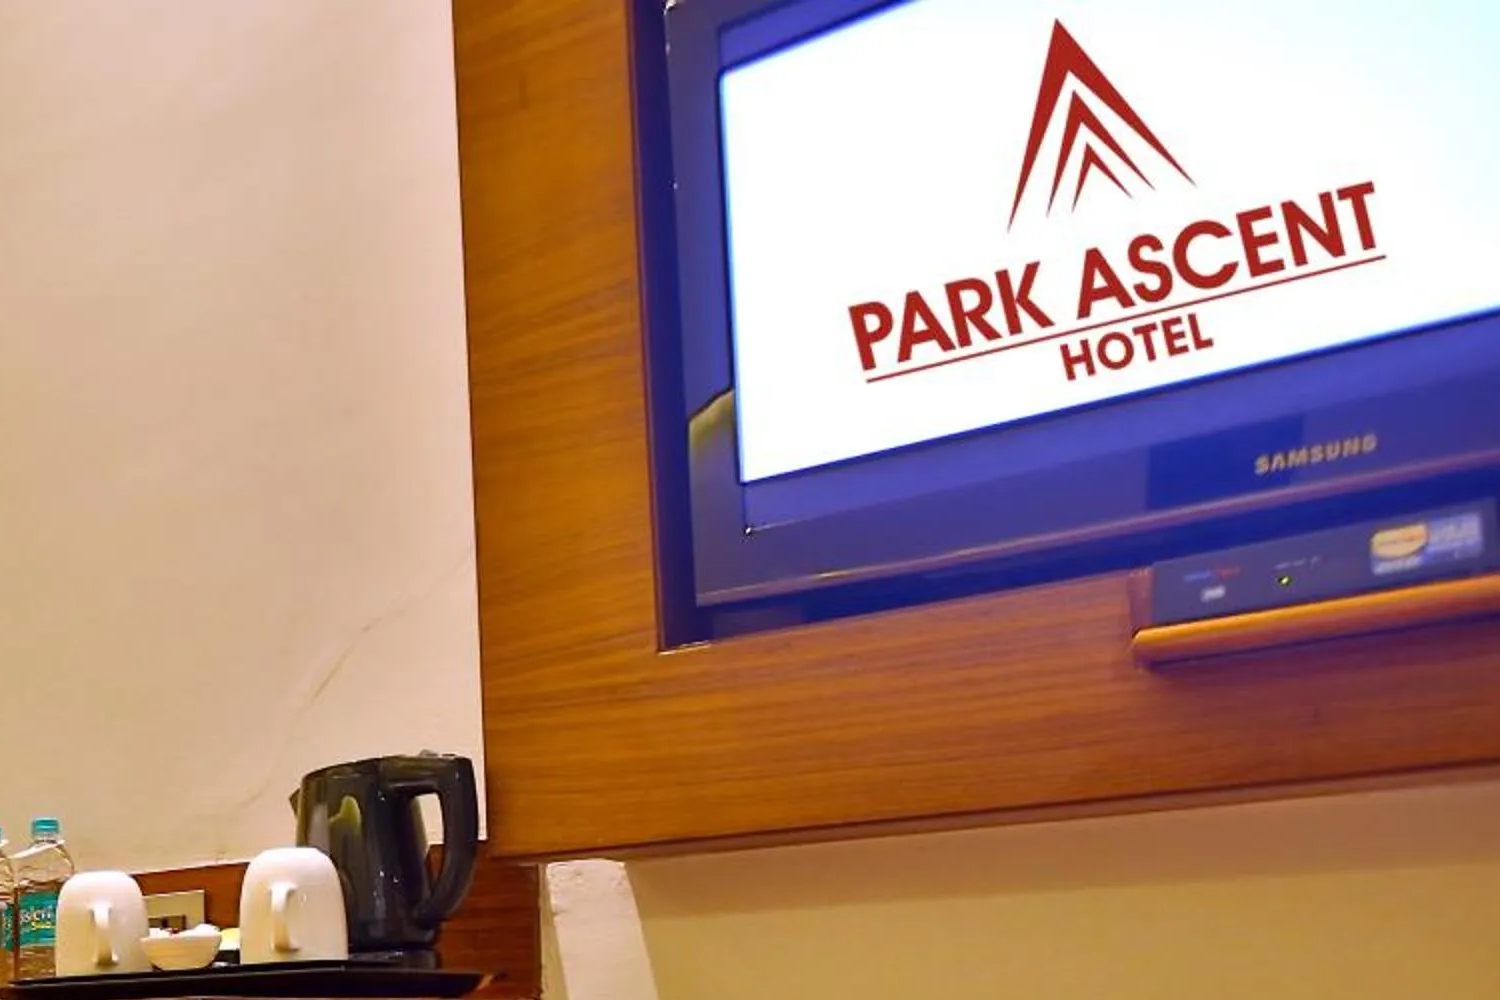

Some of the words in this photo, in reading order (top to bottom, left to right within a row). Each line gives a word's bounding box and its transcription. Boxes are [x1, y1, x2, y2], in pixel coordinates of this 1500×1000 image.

[848, 260, 1056, 372] PARK
[1076, 181, 1377, 320] ASCENT
[1059, 313, 1214, 381] HOTEL
[1254, 433, 1378, 476] SAMSUNG
